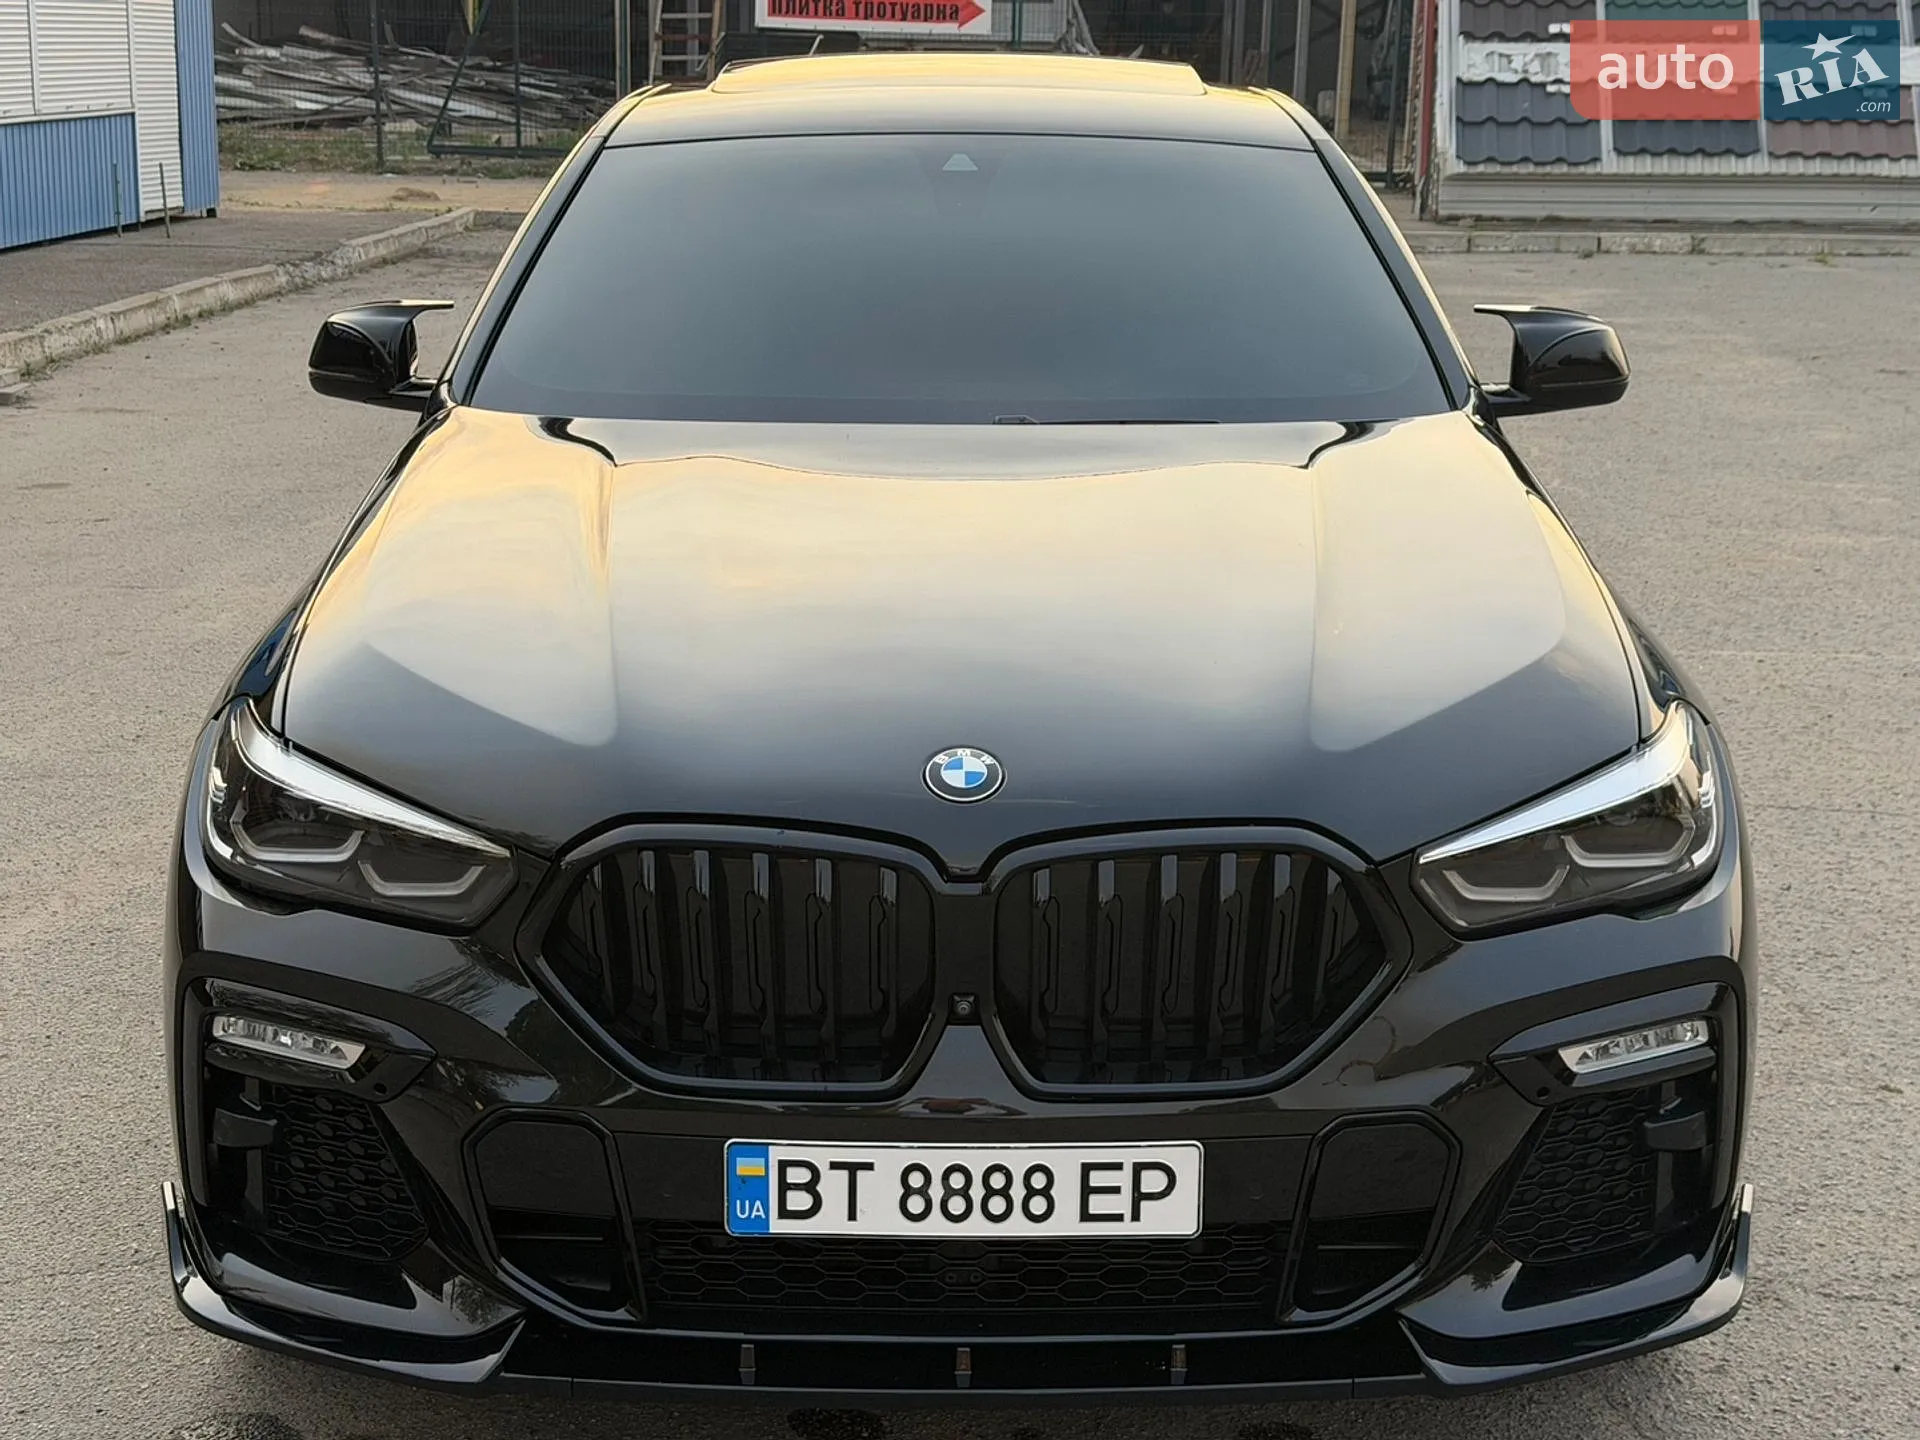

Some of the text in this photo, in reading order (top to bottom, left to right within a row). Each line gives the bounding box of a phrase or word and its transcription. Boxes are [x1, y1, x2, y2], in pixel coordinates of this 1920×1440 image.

[852, 1, 960, 21] тротуарна
[776, 1159, 1178, 1223] BT 8888 EP
[736, 1200, 766, 1219] UA
